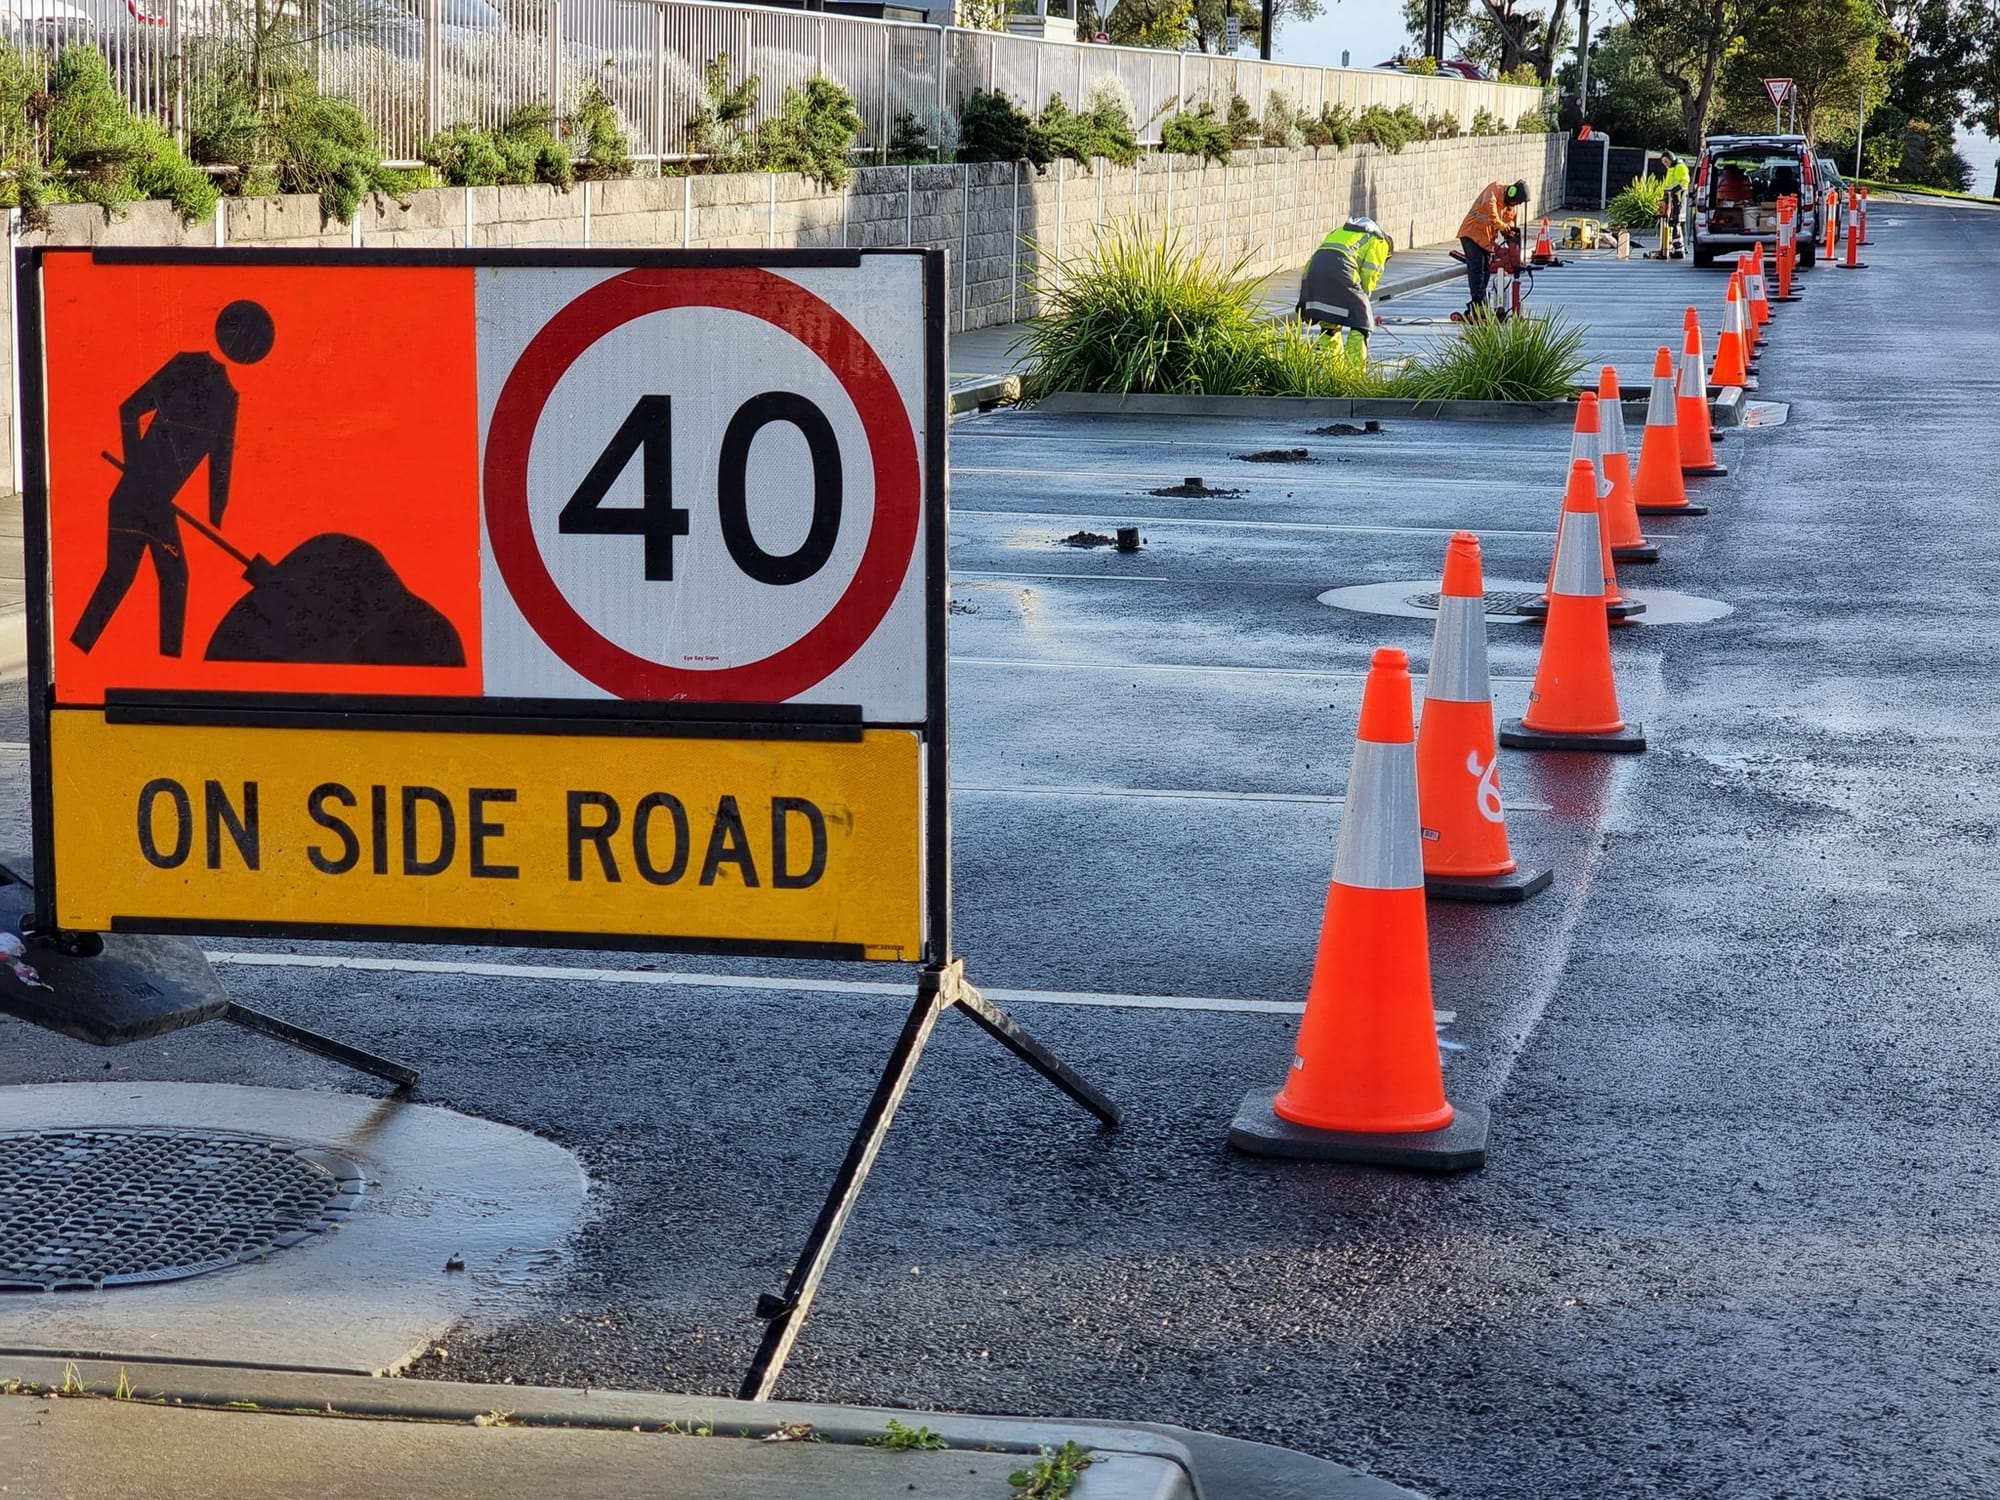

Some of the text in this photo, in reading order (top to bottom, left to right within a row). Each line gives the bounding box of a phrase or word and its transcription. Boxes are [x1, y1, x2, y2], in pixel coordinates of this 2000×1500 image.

[559, 391, 843, 585] 40
[138, 778, 827, 889] ON SIDE ROAD
